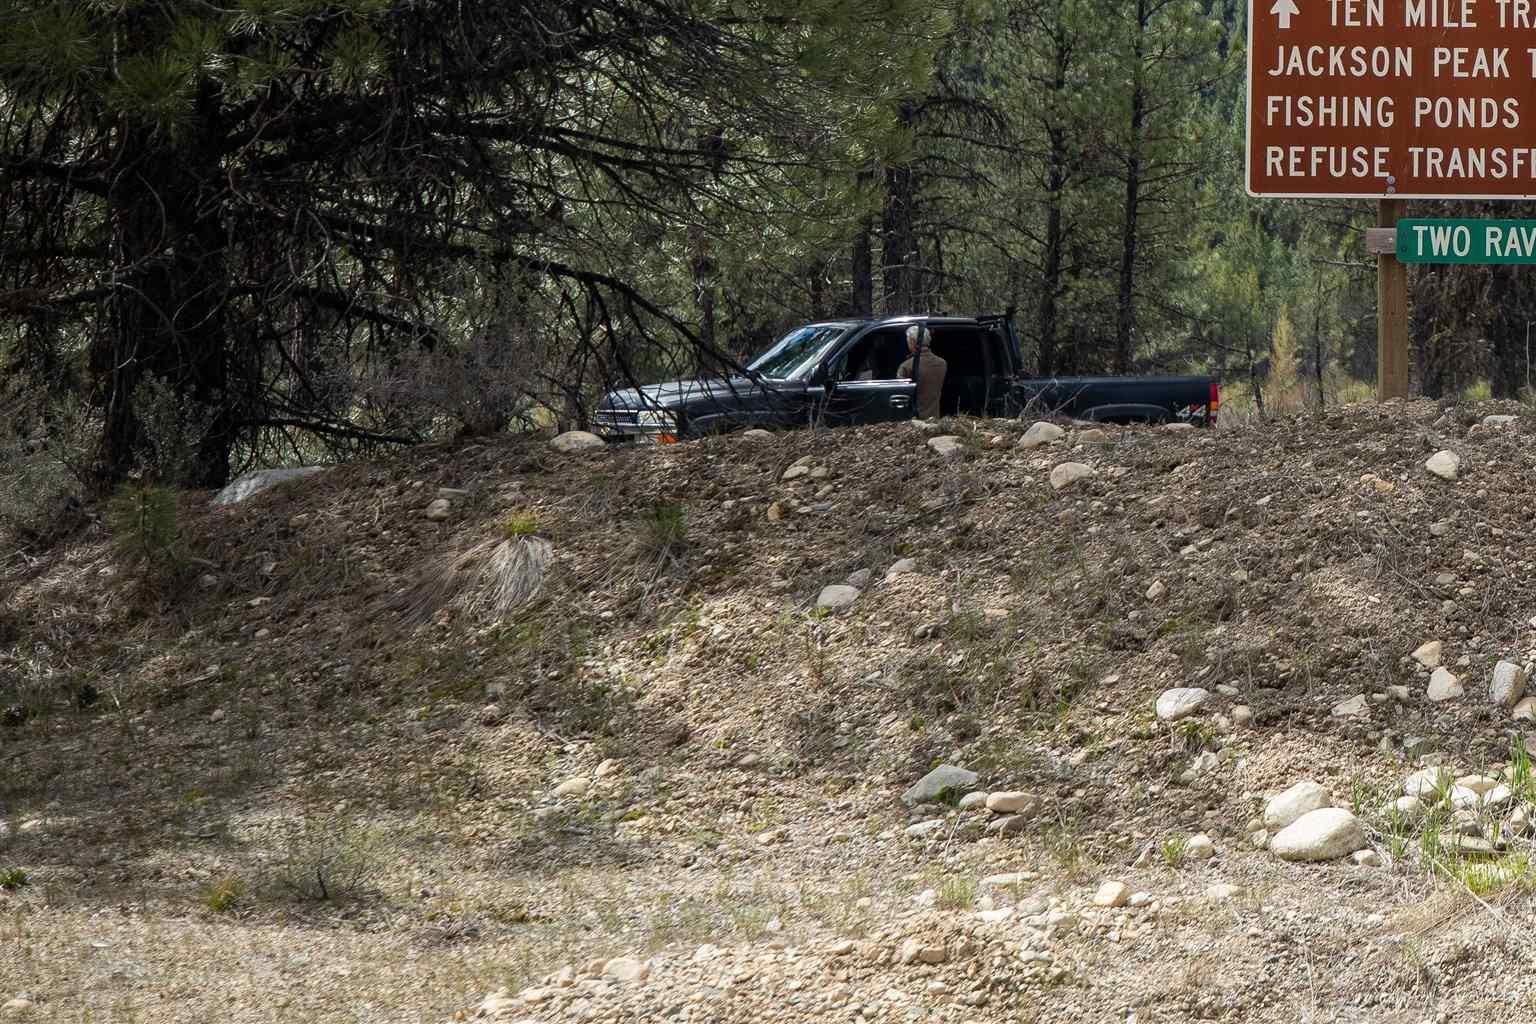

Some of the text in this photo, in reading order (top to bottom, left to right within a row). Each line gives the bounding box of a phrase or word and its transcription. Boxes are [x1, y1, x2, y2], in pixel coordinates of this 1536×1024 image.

[1268, 45, 1412, 77] JACKSON
[1433, 47, 1510, 78] PEAK
[1267, 95, 1520, 129] FISHING PONDS
[1266, 146, 1390, 178] REFUSE
[1413, 225, 1471, 257] TWO
